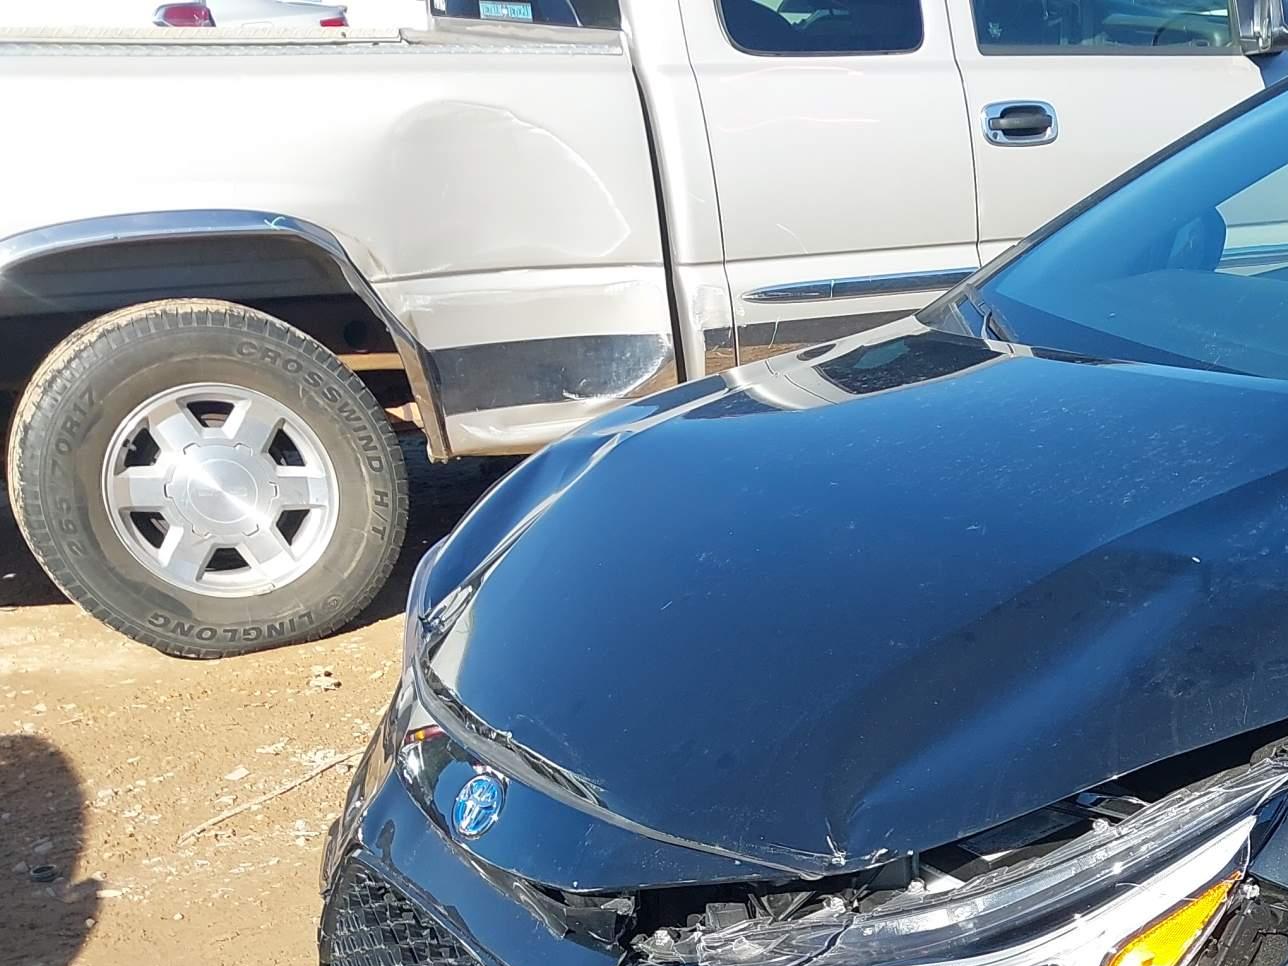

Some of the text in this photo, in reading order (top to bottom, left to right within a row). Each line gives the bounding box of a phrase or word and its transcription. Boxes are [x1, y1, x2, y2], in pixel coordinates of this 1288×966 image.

[237, 341, 389, 541] CROSSWIND H/T
[147, 611, 315, 642] LINGLONG
